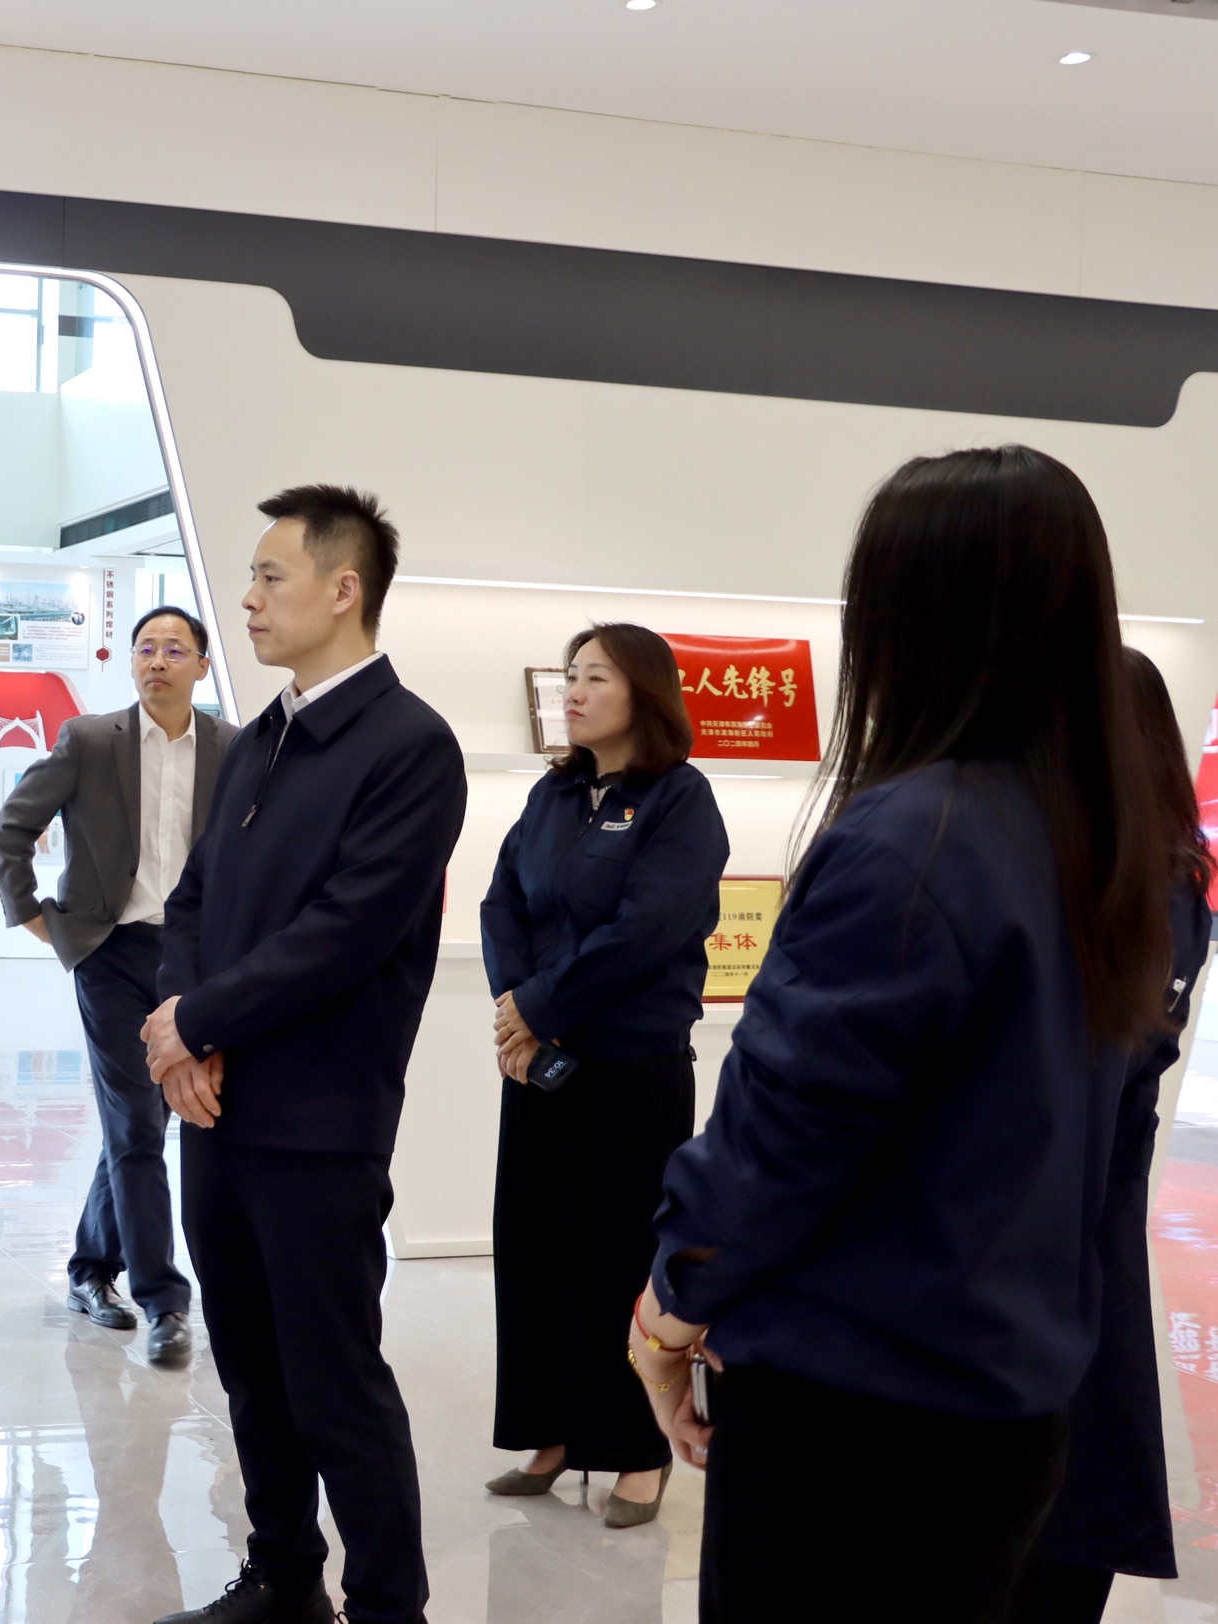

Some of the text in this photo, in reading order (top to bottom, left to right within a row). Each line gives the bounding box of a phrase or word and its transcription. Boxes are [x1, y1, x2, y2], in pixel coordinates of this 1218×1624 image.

[105, 570, 114, 638] 不锈钢系列焊材
[719, 912, 762, 921] 119消防奖
[709, 932, 758, 951] 集体
[544, 1060, 564, 1078] 10:34
